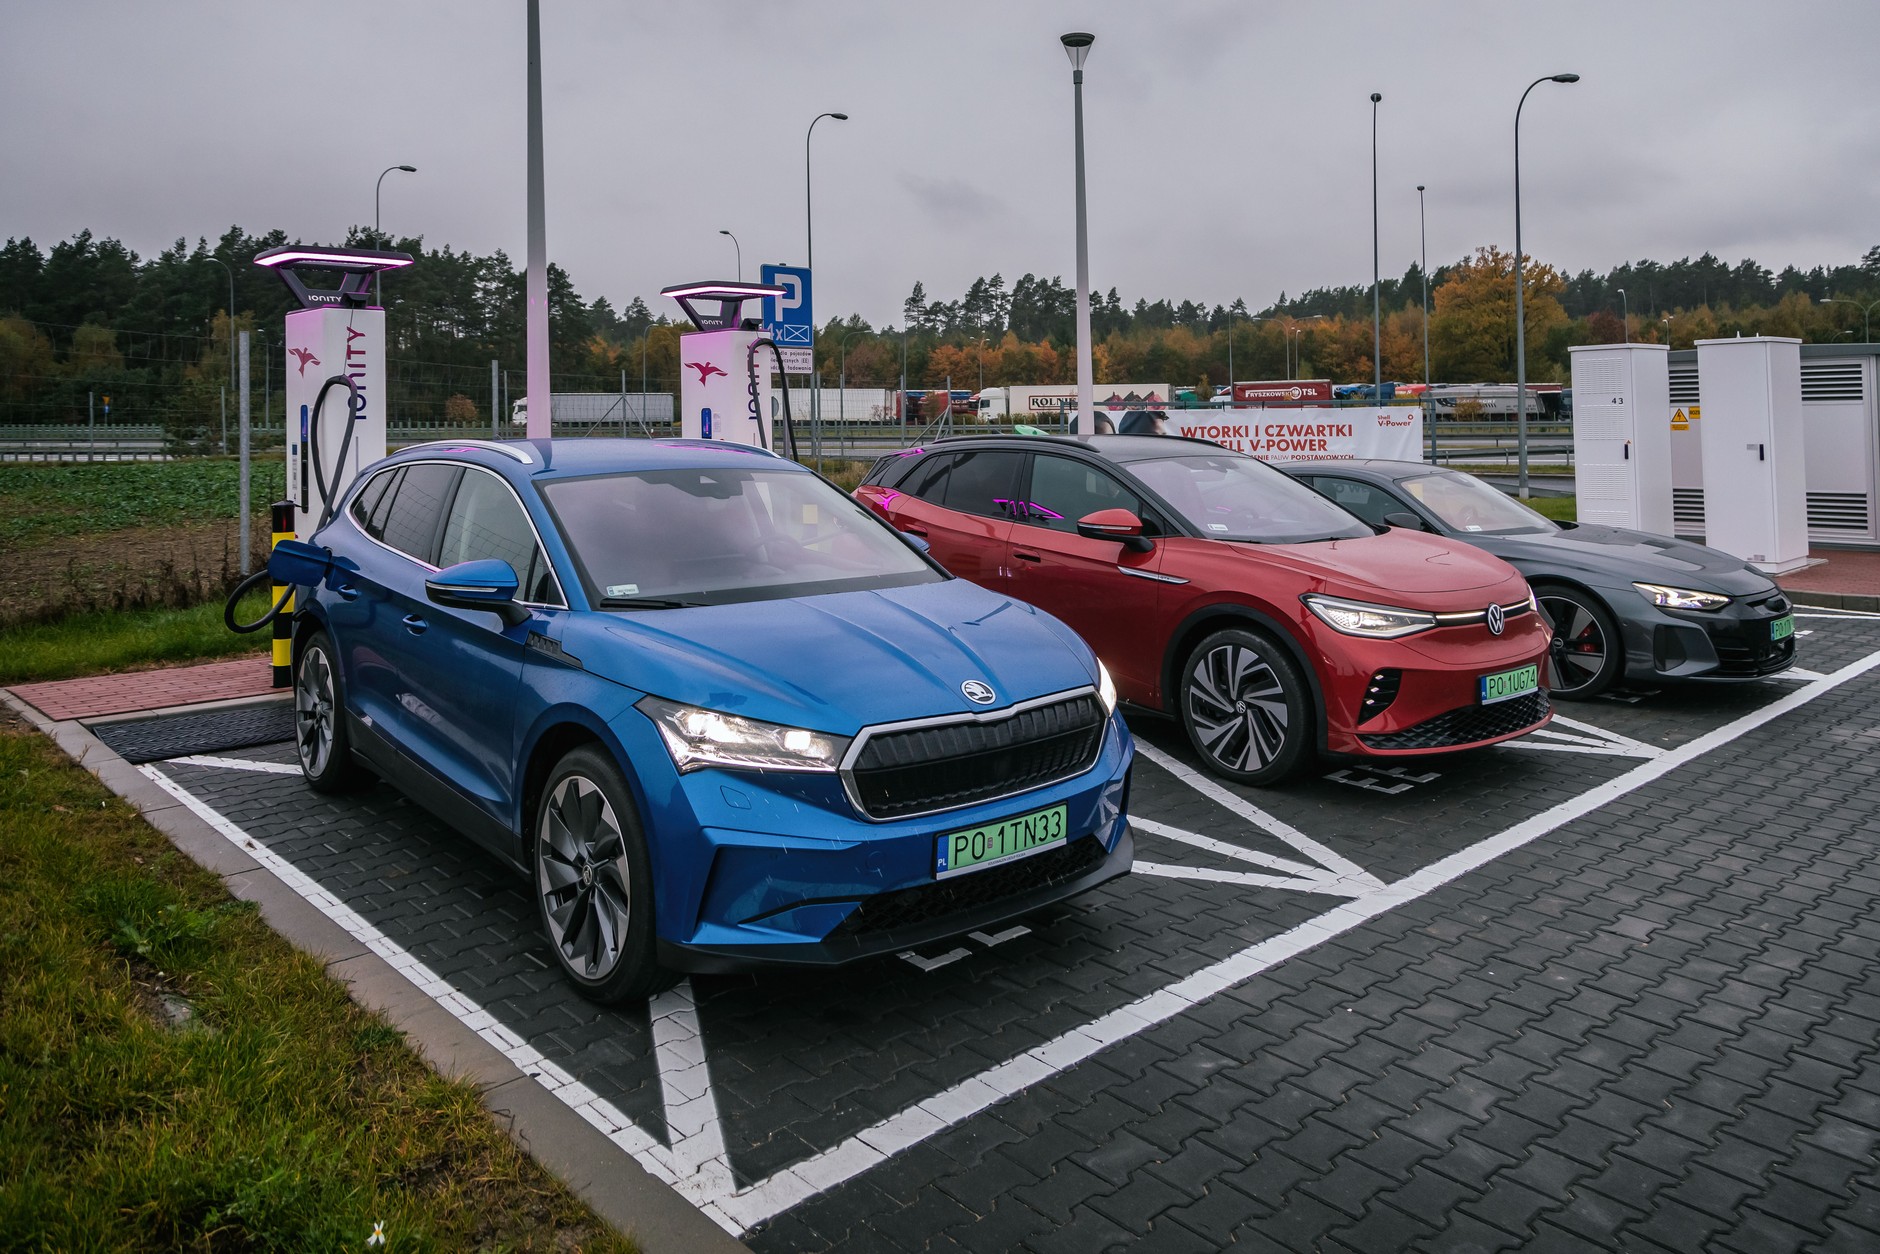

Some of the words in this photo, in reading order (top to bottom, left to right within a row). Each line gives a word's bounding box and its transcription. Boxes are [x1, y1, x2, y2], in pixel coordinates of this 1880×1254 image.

[308, 294, 342, 303] IONITY
[774, 273, 802, 322] P
[1302, 388, 1318, 396] TSL
[1180, 425, 1249, 439] WTORKI
[1255, 425, 1259, 438] I
[1264, 424, 1353, 437] CZWARTKI
[1250, 439, 1328, 452] V-POWER
[1507, 668, 1536, 692] 1UG74
[954, 831, 986, 866] PO
[997, 810, 1061, 854] 1TN33
[937, 858, 947, 867] PL
